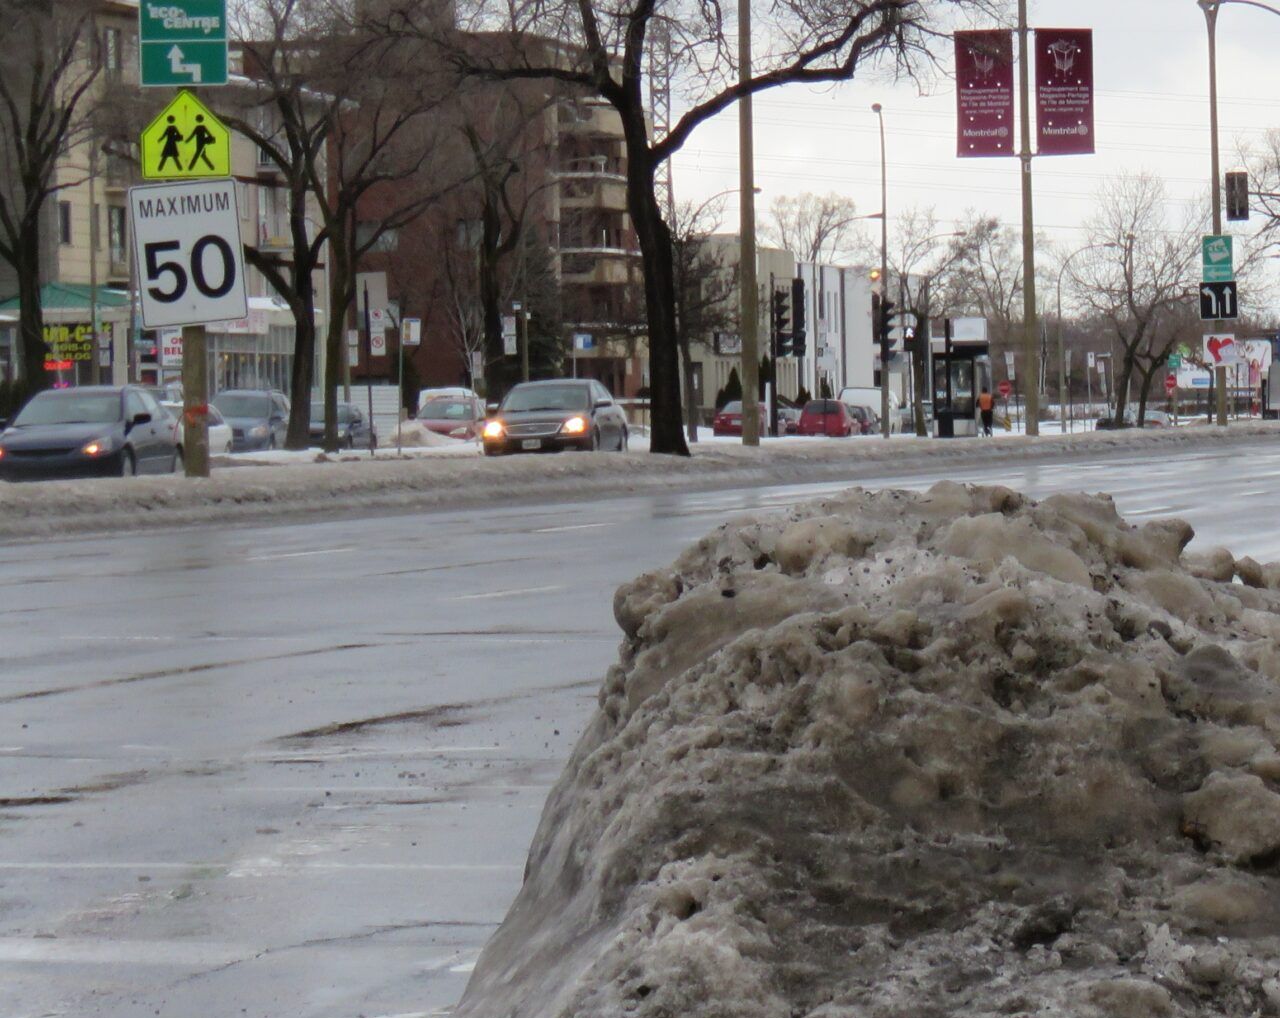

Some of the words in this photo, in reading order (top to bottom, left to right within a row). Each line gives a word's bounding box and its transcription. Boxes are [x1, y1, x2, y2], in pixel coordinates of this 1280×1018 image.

[963, 128, 998, 136] Montréal
[1042, 126, 1077, 135] Montréal
[139, 192, 230, 217] MAXIMUM
[144, 234, 236, 303] 50
